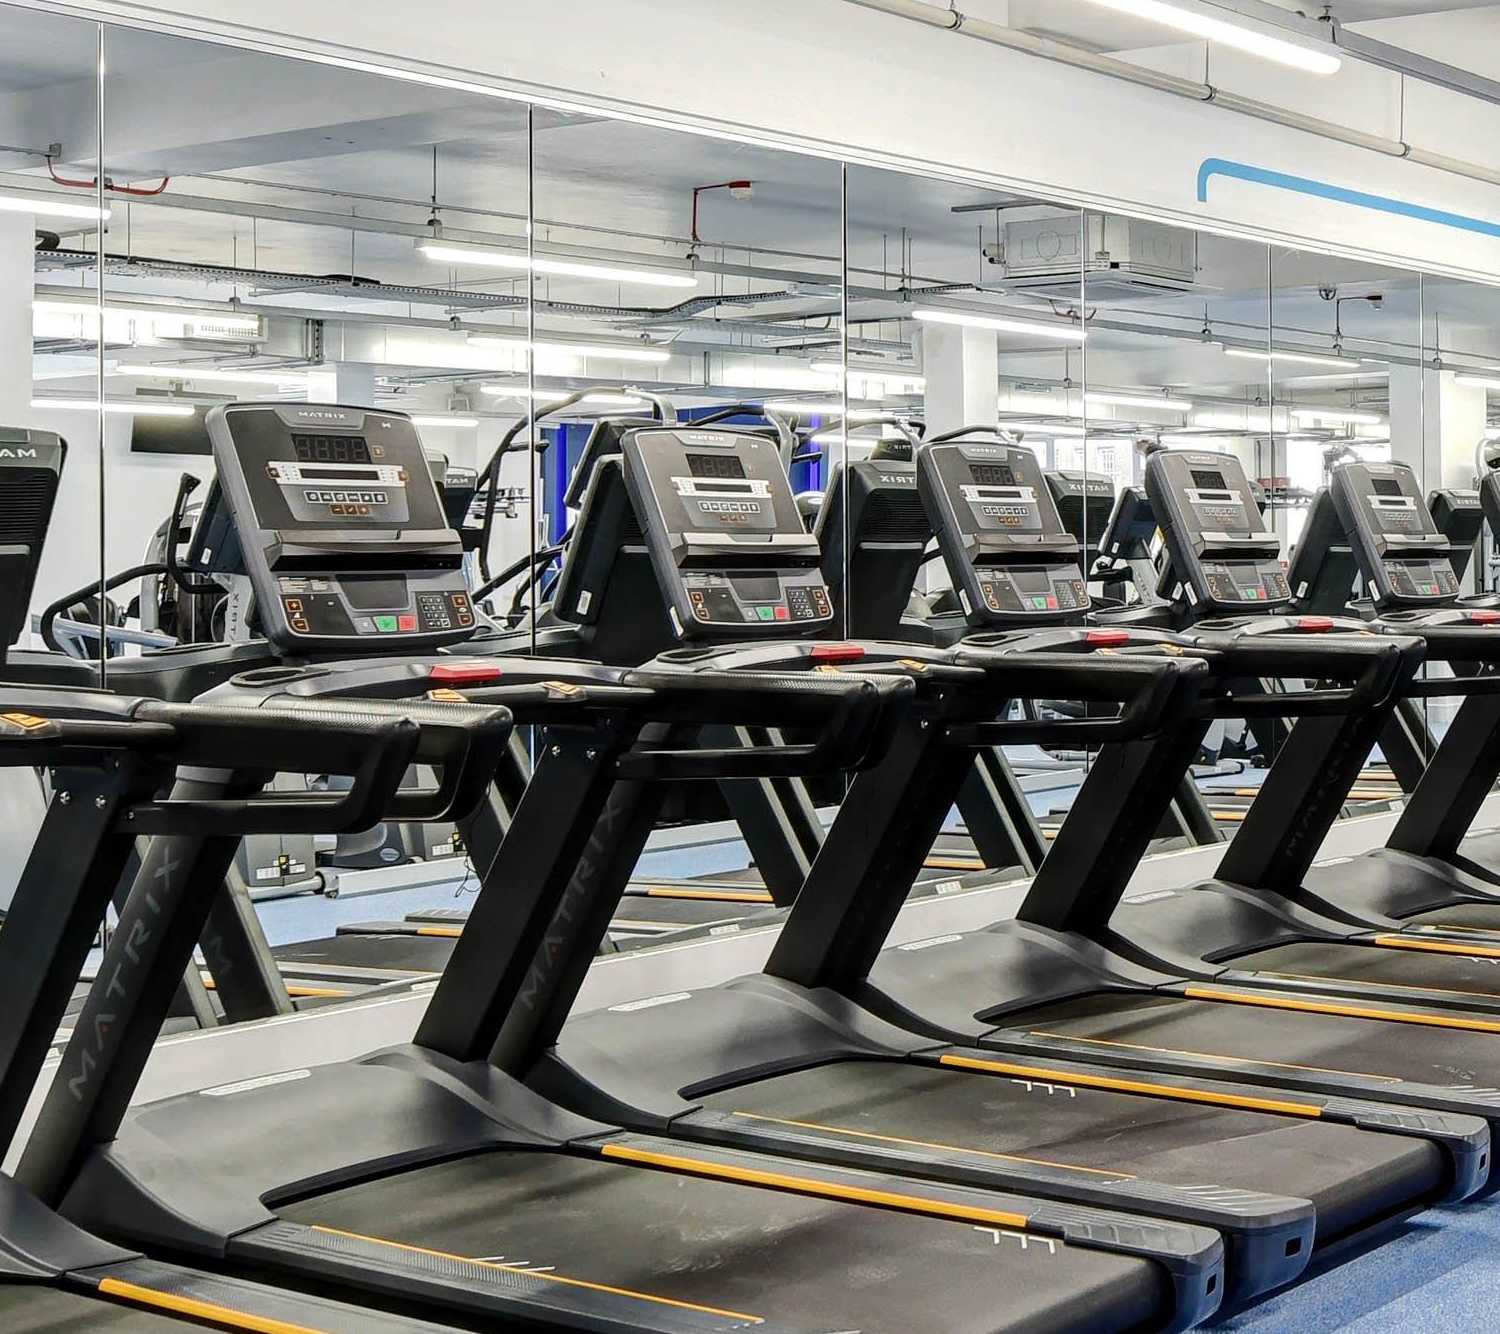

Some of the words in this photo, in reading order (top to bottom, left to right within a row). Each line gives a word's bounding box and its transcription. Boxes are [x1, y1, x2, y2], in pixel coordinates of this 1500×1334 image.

[298, 411, 345, 420] MATRIX
[689, 434, 725, 442] MATRIX
[520, 799, 623, 1011] MATRIX
[69, 843, 181, 1102] MATRIX
